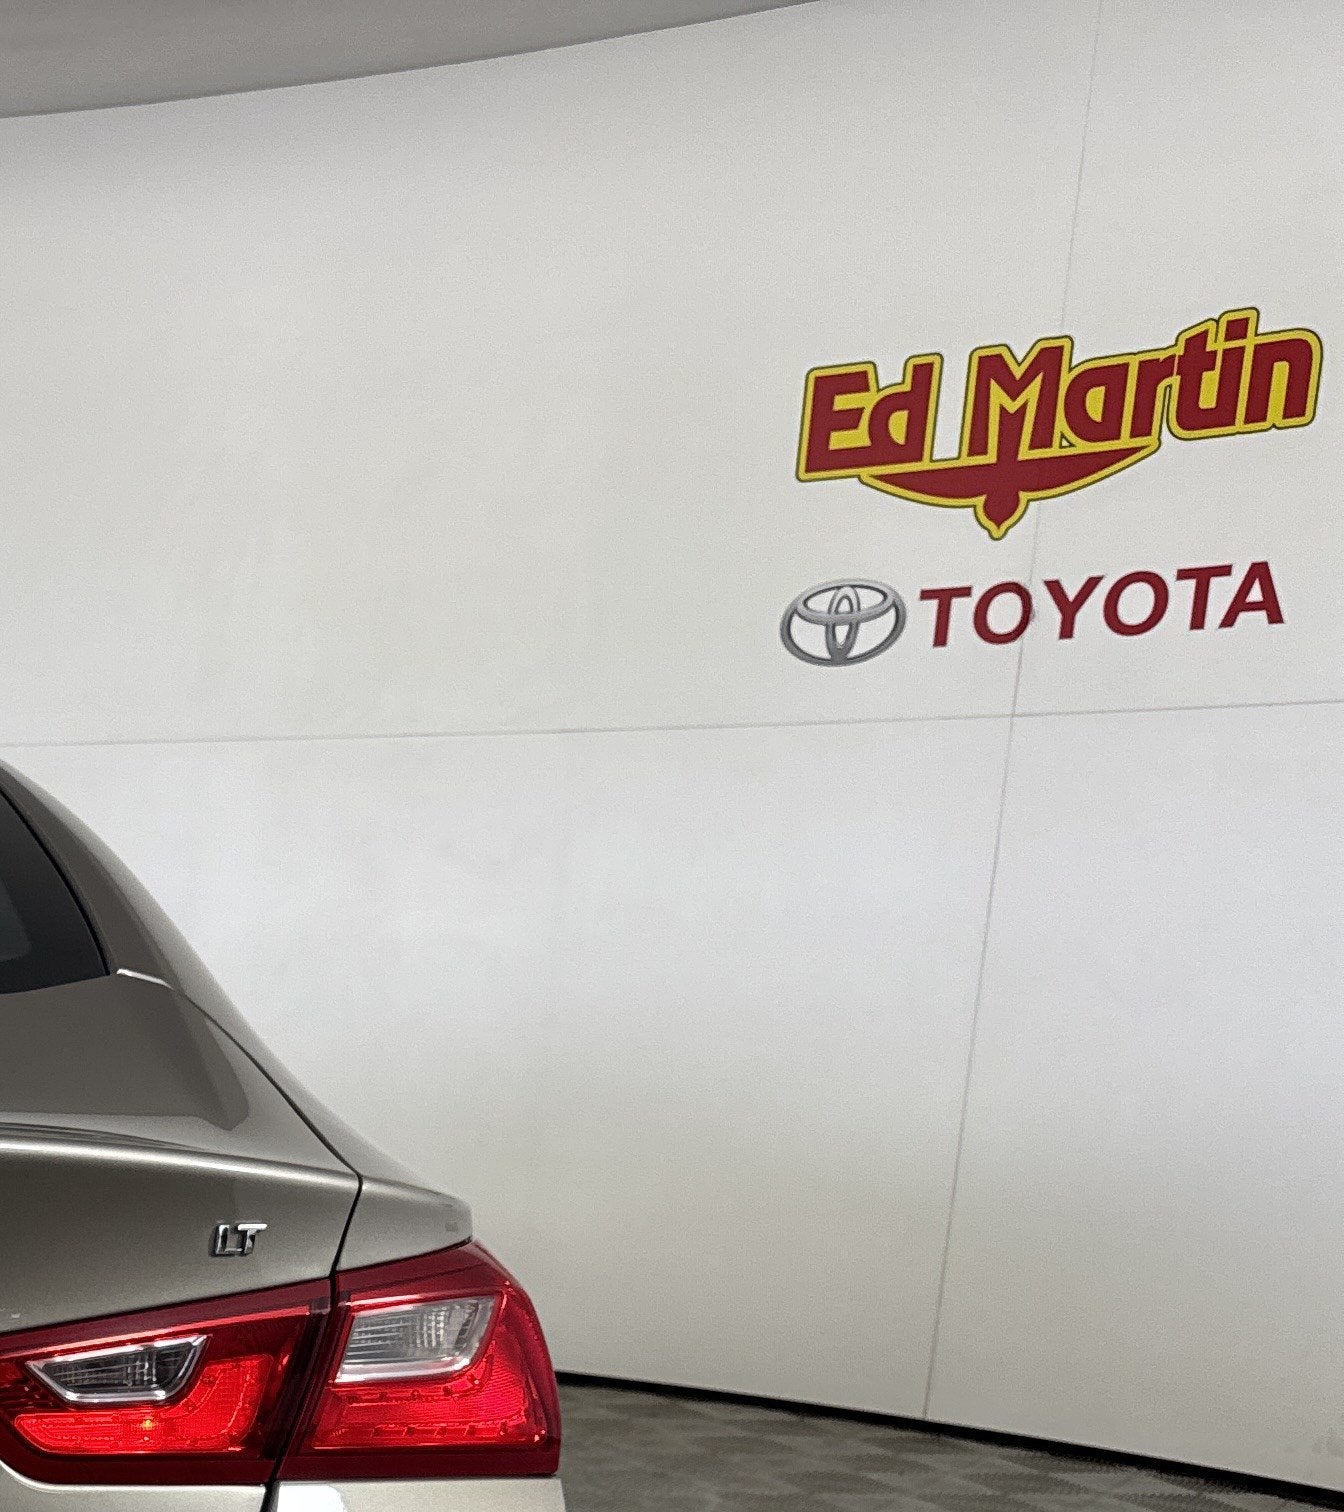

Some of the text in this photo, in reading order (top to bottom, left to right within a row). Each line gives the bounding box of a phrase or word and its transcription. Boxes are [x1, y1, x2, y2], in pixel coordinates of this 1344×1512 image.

[797, 307, 1323, 482] Ed Martin
[919, 561, 1285, 648] TOYOTA
[209, 1222, 269, 1257] LT
